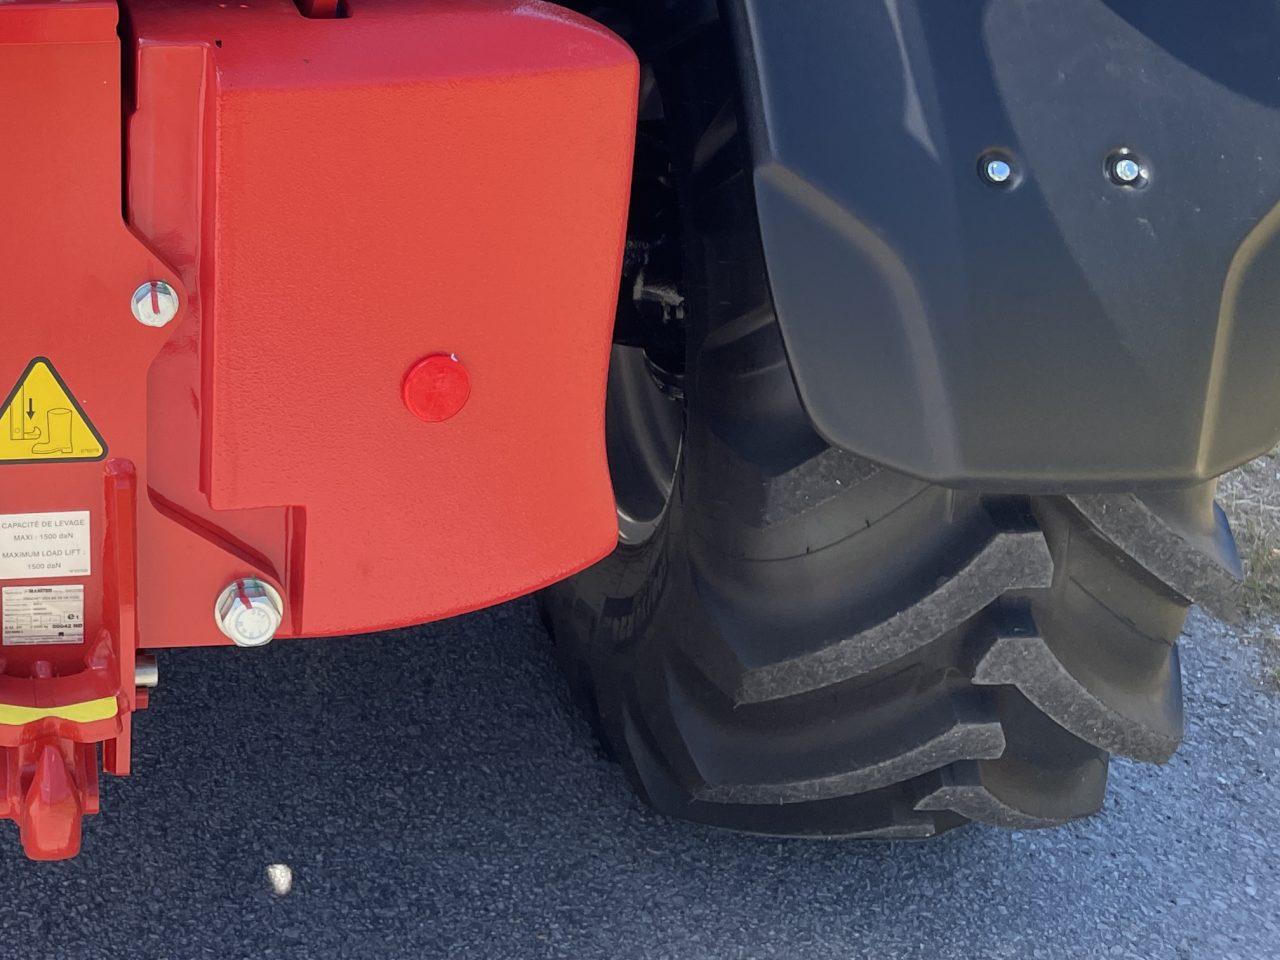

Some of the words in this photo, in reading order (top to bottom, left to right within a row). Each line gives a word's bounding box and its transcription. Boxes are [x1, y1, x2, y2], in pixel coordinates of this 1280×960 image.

[1, 520, 40, 529] CAPACITÉ
[41, 520, 53, 528] DE
[54, 519, 85, 527] LEVAGE
[1, 551, 40, 559] MAXIMUM
[41, 550, 63, 558] LOAD
[27, 563, 45, 571] 1500
